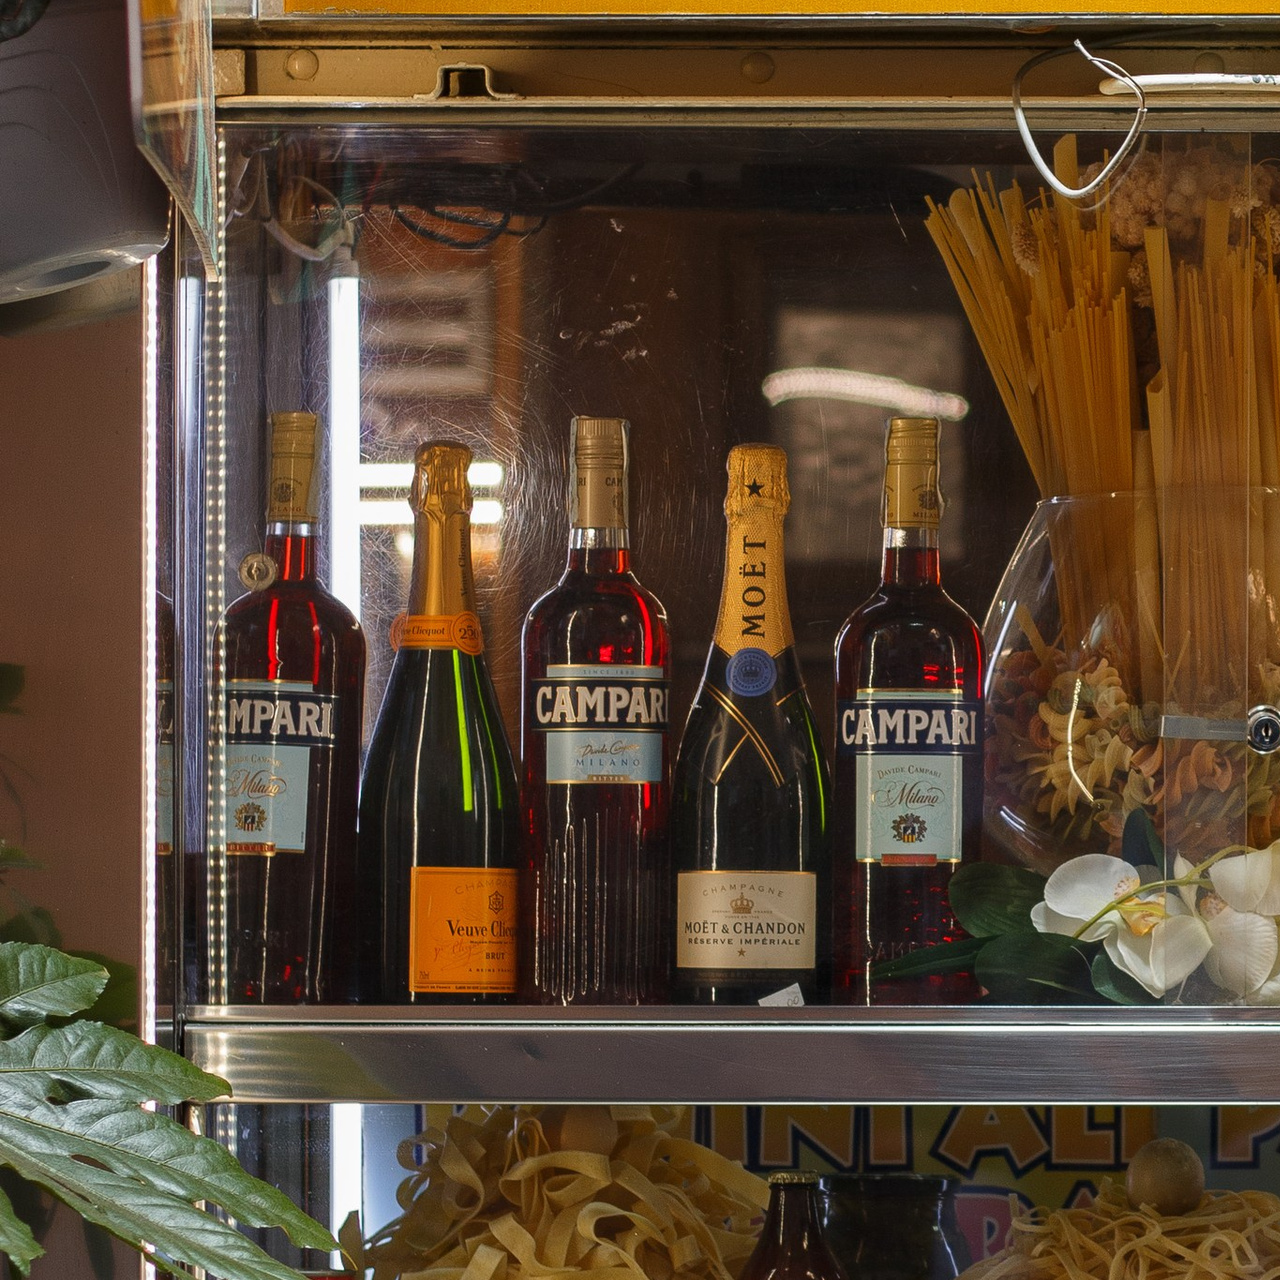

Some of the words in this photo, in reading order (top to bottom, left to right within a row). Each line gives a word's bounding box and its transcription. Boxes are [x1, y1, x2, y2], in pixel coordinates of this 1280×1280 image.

[738, 534, 767, 639] MOËT
[536, 685, 670, 724] CAMPARI
[841, 708, 977, 746] CAMPARI
[575, 758, 641, 768] MILANO
[878, 780, 946, 809] Milano
[702, 883, 785, 898] CHAMPAGNE
[446, 919, 488, 937] Veuve
[684, 919, 719, 934] MOËT
[721, 923, 730, 934] &
[732, 921, 806, 935] CHANDON
[687, 936, 734, 946] RÉSERVE
[739, 937, 801, 946] IMPÉRIALE
[485, 951, 506, 960] BRUT
